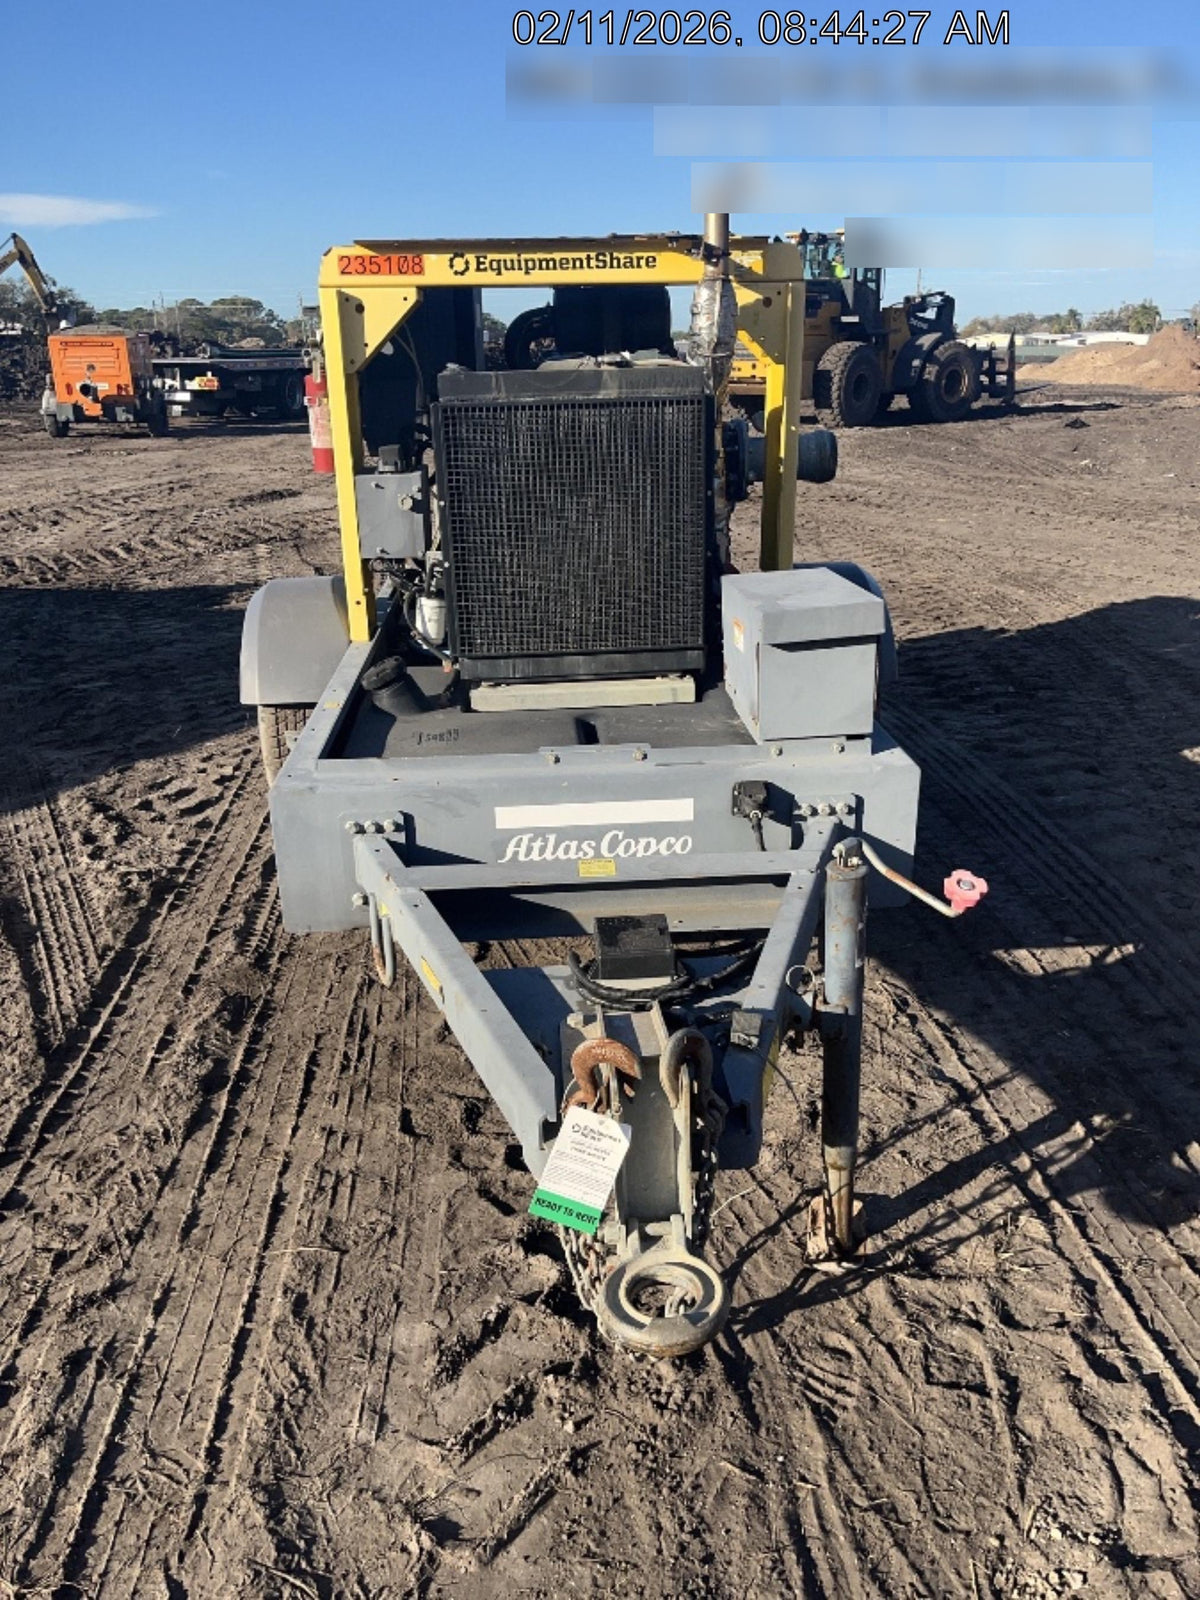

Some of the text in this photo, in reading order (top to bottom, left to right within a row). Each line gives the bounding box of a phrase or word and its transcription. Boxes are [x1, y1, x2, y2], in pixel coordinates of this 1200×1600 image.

[339, 255, 424, 275] 235108
[474, 252, 657, 275] EquipmentShare
[497, 829, 693, 863] Atlas Copco
[534, 1197, 598, 1225] READY TO RENT
